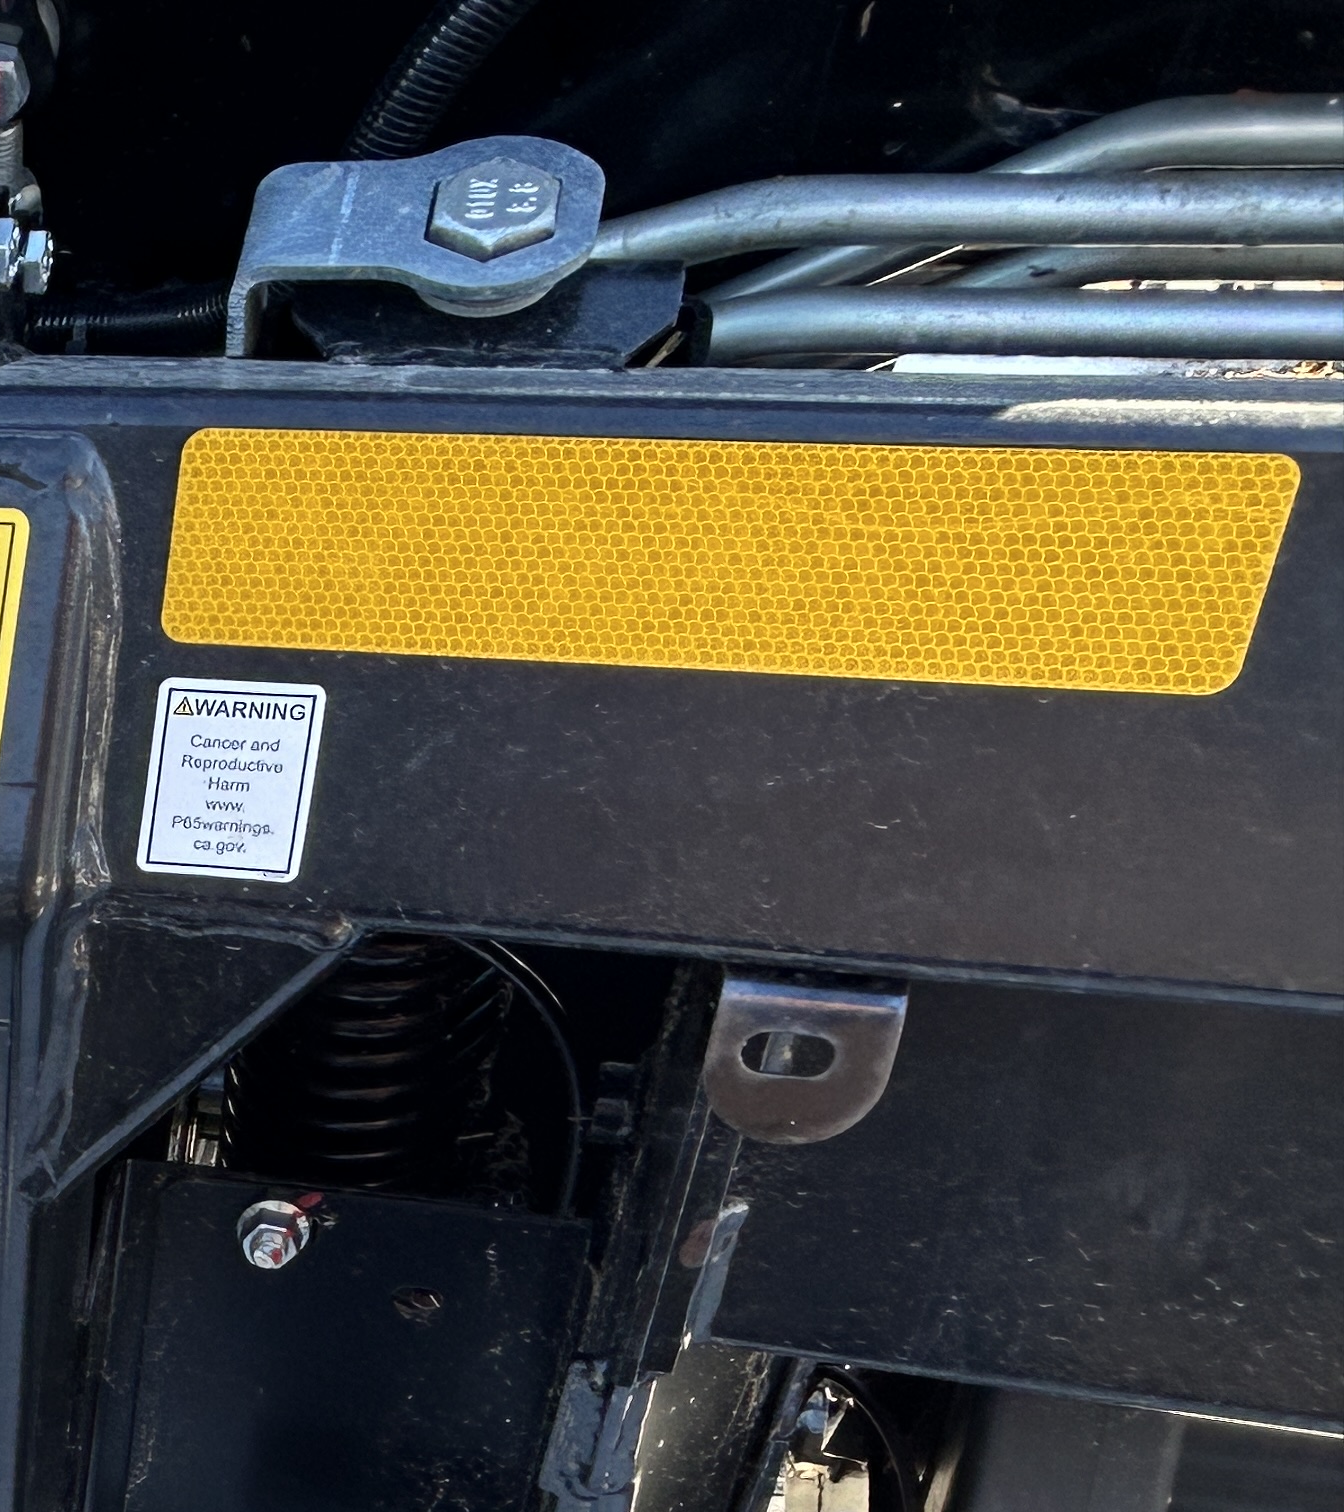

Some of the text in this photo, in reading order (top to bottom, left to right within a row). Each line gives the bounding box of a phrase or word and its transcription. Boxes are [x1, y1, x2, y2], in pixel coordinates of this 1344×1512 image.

[195, 698, 306, 721] WARNING
[190, 734, 280, 752] Cancer and
[181, 754, 283, 774] Reproductive
[208, 776, 250, 792] Harm
